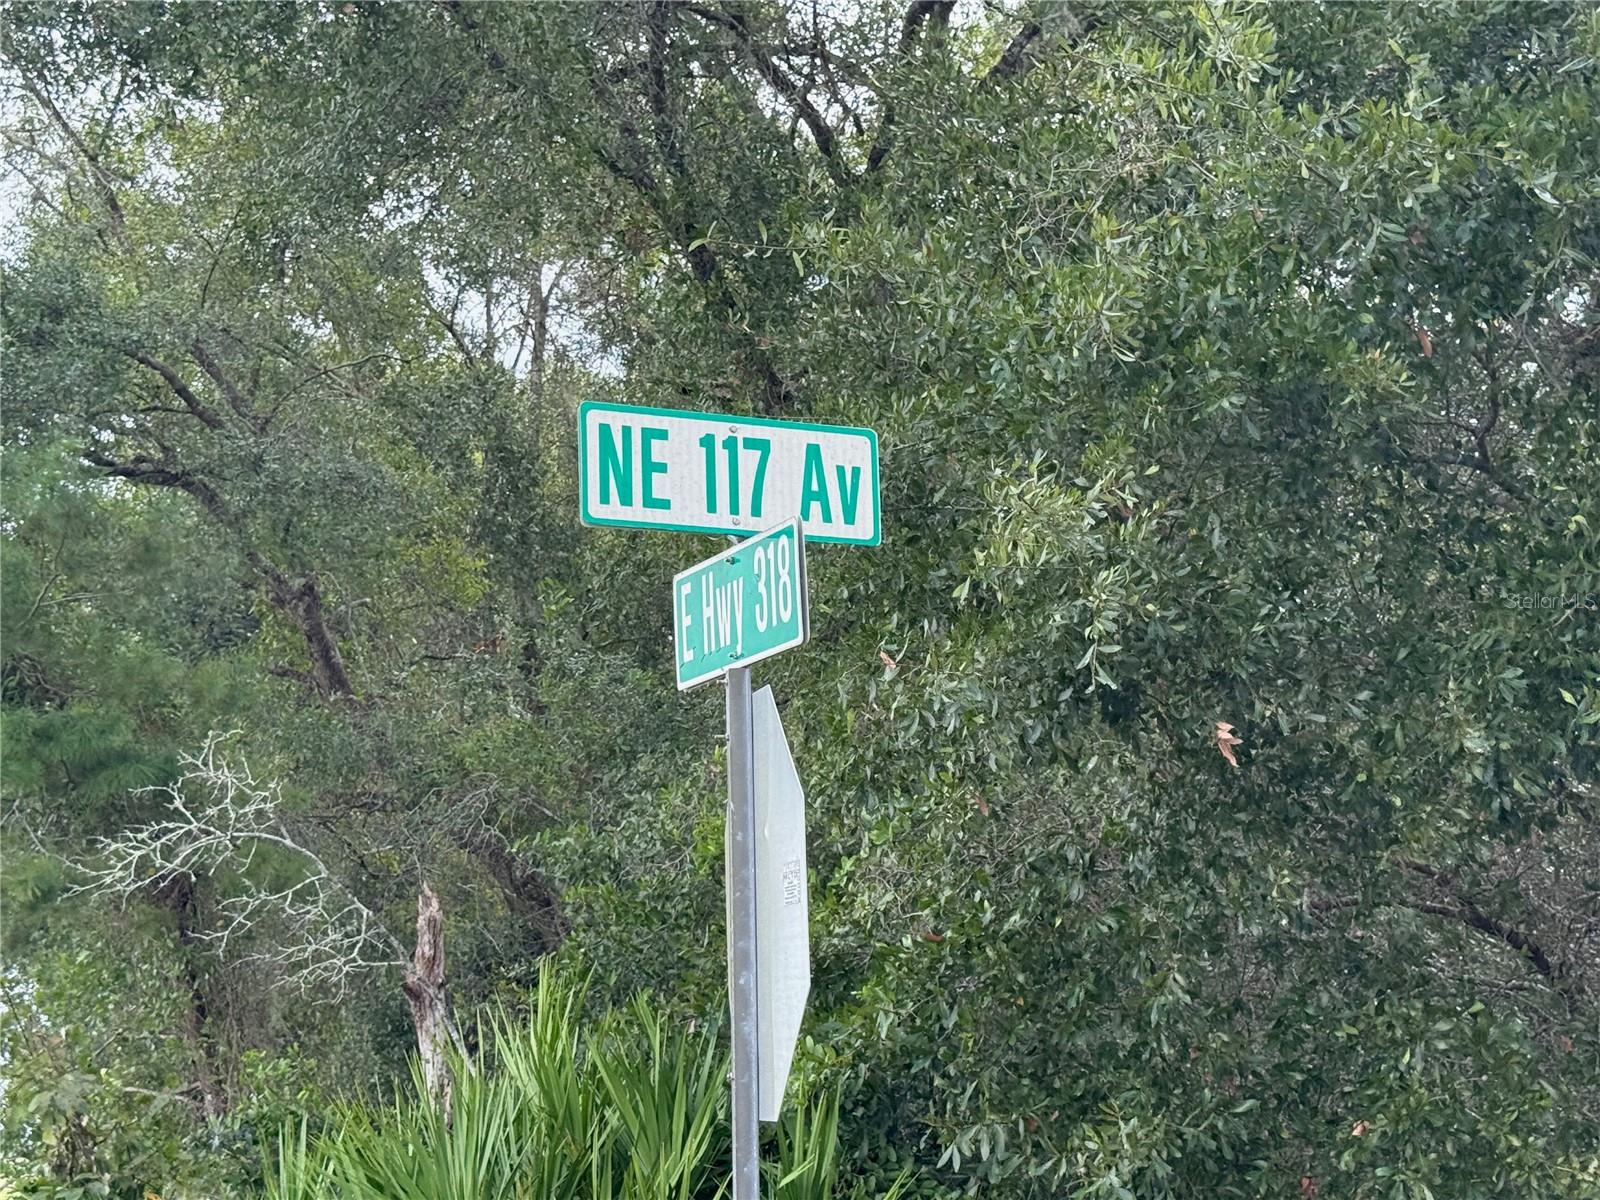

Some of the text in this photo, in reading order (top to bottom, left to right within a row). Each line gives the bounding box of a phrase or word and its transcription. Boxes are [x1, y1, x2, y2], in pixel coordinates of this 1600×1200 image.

[598, 422, 861, 526] NE 117 Av
[680, 534, 792, 663] E Hwy 318
